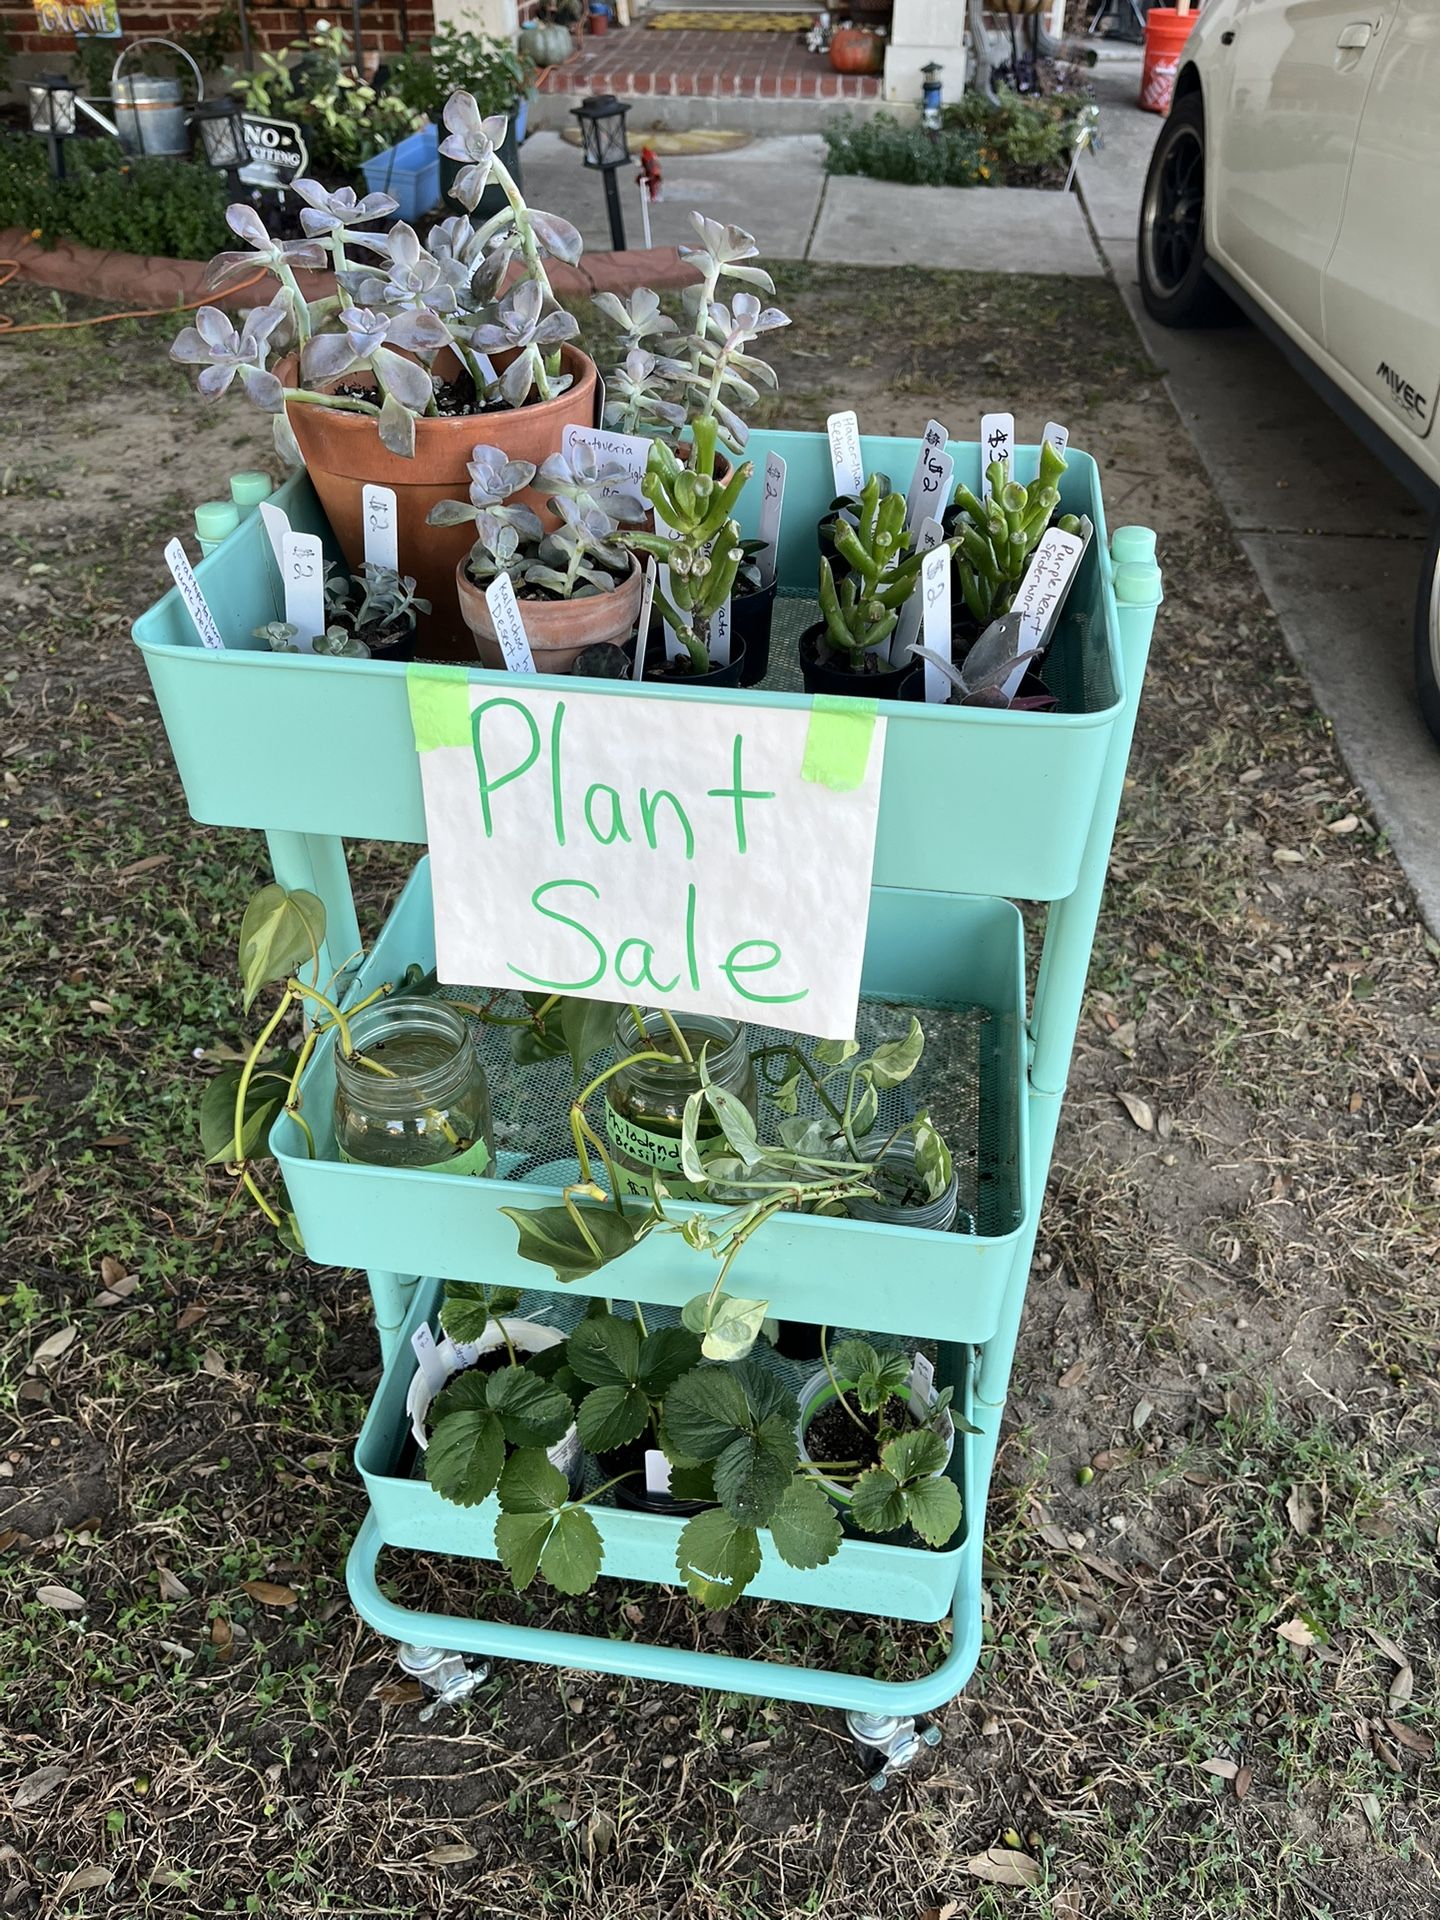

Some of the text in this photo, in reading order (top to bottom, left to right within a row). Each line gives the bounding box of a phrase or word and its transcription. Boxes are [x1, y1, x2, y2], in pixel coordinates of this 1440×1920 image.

[243, 124, 280, 148] NO
[1376, 361, 1426, 420] MIVEC
[765, 463, 782, 501] $2
[922, 457, 944, 493] $2
[368, 495, 390, 533] $2
[291, 545, 316, 580] $2
[1030, 544, 1075, 636] Purple heart
[471, 697, 776, 860] Plant
[506, 878, 810, 1004] Sale
